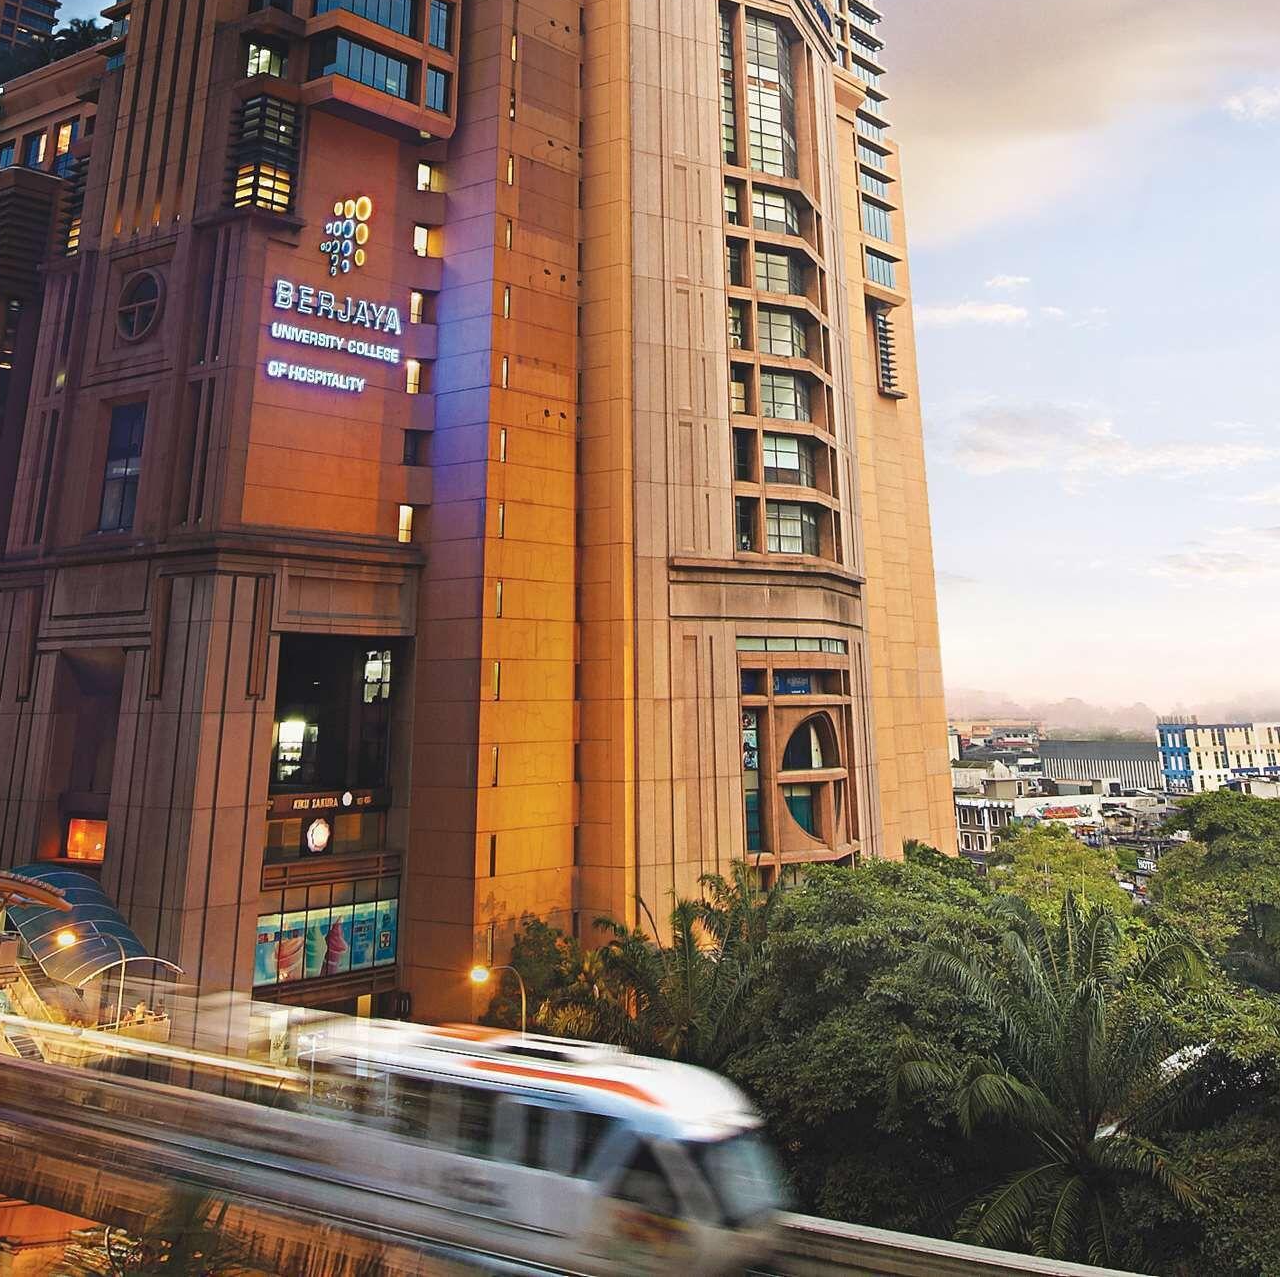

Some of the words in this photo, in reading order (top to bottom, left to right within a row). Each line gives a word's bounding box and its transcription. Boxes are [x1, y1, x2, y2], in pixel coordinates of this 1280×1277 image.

[275, 279, 402, 335] BERJAYA
[271, 322, 345, 350] UNIVERSITY
[348, 340, 400, 363] COLLEGE
[267, 360, 287, 378] OF
[289, 365, 365, 392] HOSPITALITY
